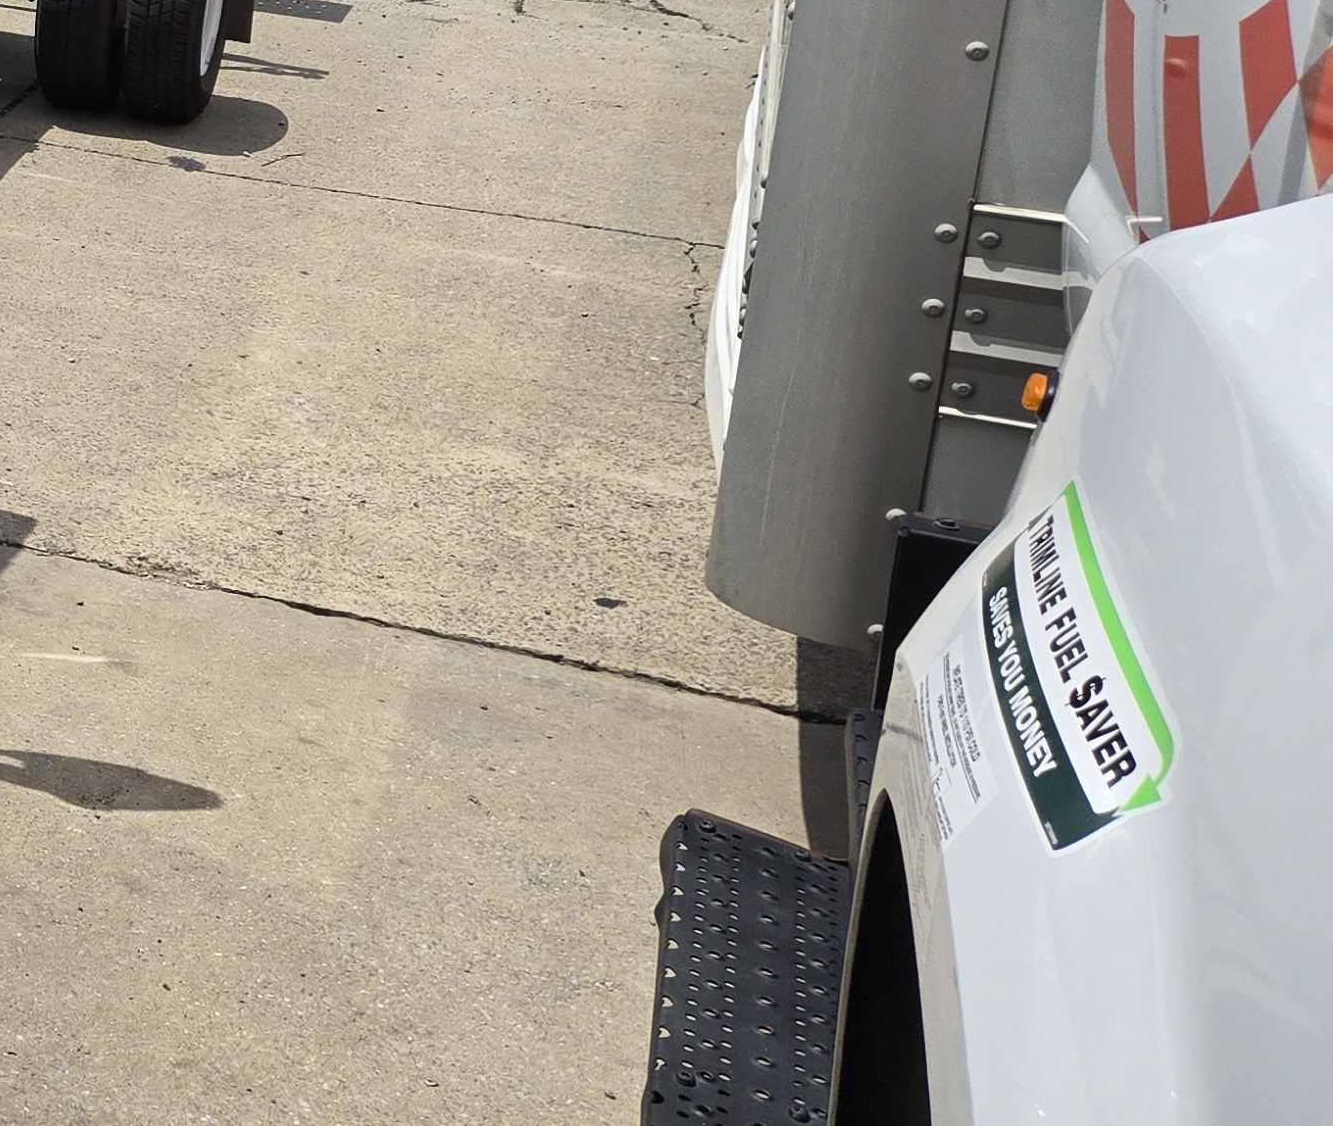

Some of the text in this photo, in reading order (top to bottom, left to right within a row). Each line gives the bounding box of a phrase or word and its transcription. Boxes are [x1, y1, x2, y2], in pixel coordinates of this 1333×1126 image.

[1028, 514, 1067, 616] TRIMLINE
[988, 585, 1057, 778] SAVES YOU MONEY
[1044, 606, 1089, 683] FUEL
